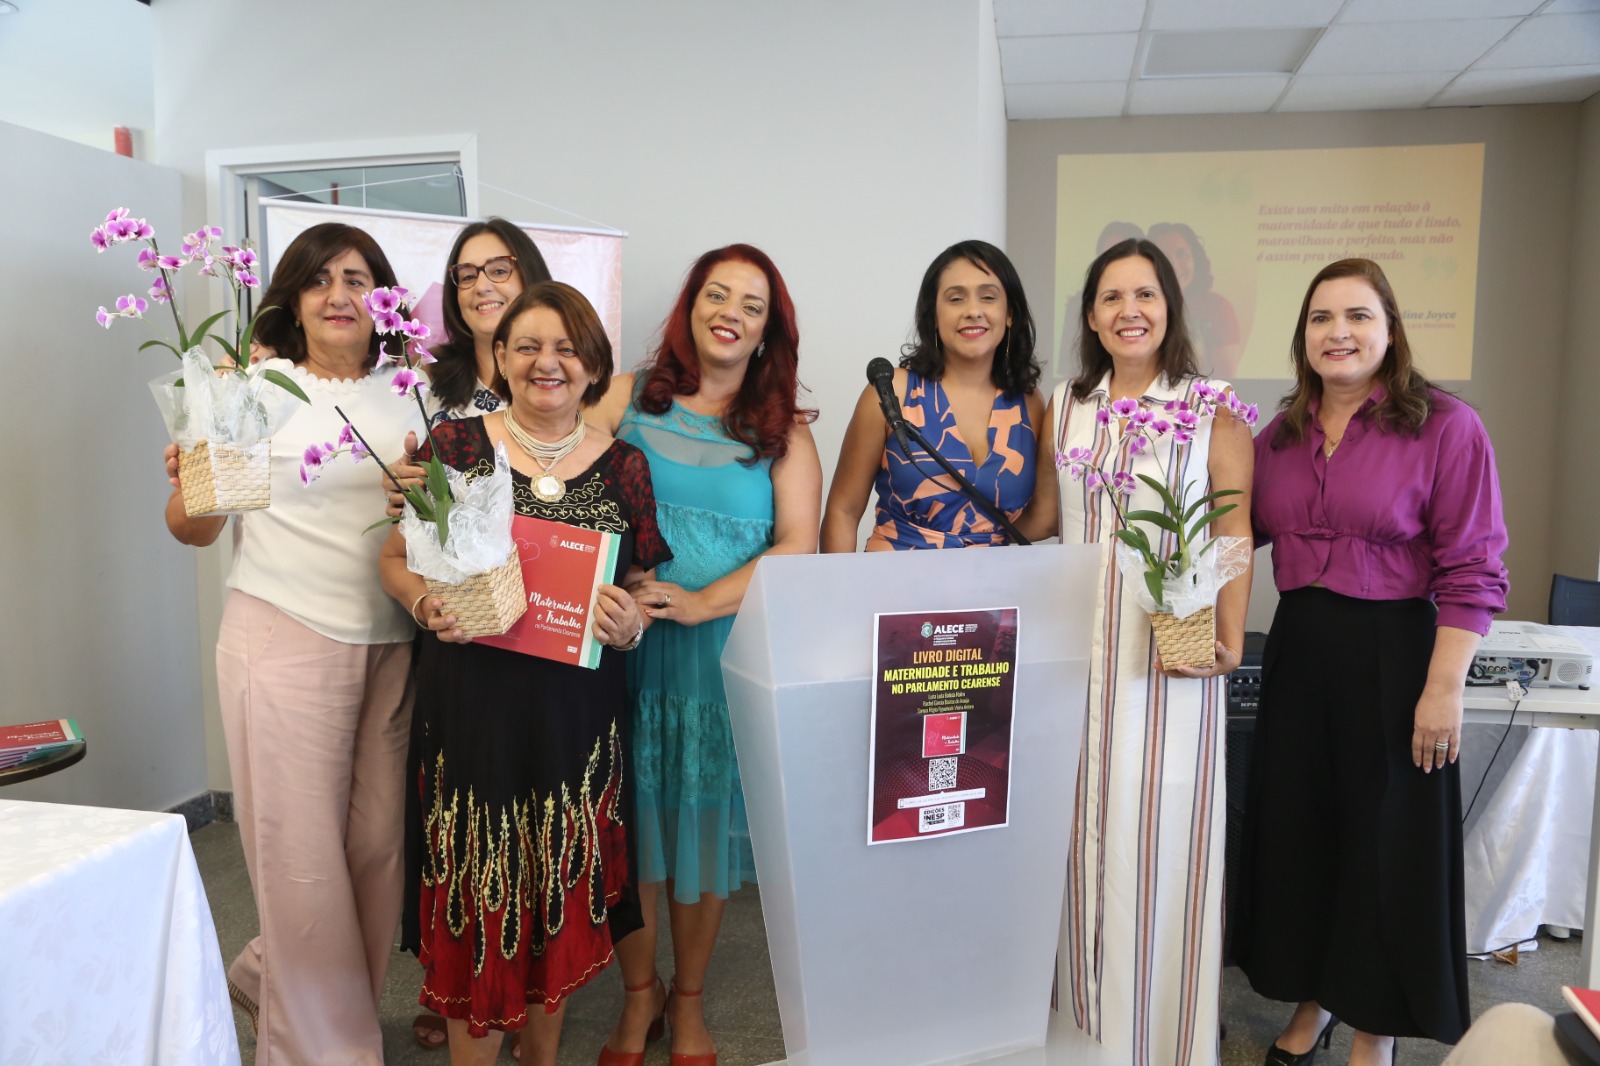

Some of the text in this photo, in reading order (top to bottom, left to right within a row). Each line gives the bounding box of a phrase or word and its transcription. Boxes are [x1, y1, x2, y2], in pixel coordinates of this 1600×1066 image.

[1258, 200, 1431, 216] Existe um mito em relação à
[1257, 215, 1461, 234] maternidade de que tudo é lindo,
[1257, 232, 1454, 250] maravilhoso e perfeito, mas não
[1256, 250, 1264, 262] é
[1265, 250, 1301, 262] assim
[1303, 251, 1325, 265] pra
[1426, 309, 1457, 321] Joyce
[559, 540, 585, 552] ALECE
[529, 591, 585, 615] Maternidade
[546, 610, 583, 630] Trabalho
[933, 624, 965, 635] ALECE
[913, 648, 983, 665] LIVRO DIGITAL
[884, 661, 1010, 682] MATERNIDADE E TRABALHO
[892, 676, 1001, 695] NO PARLAMENTO CEARENSE
